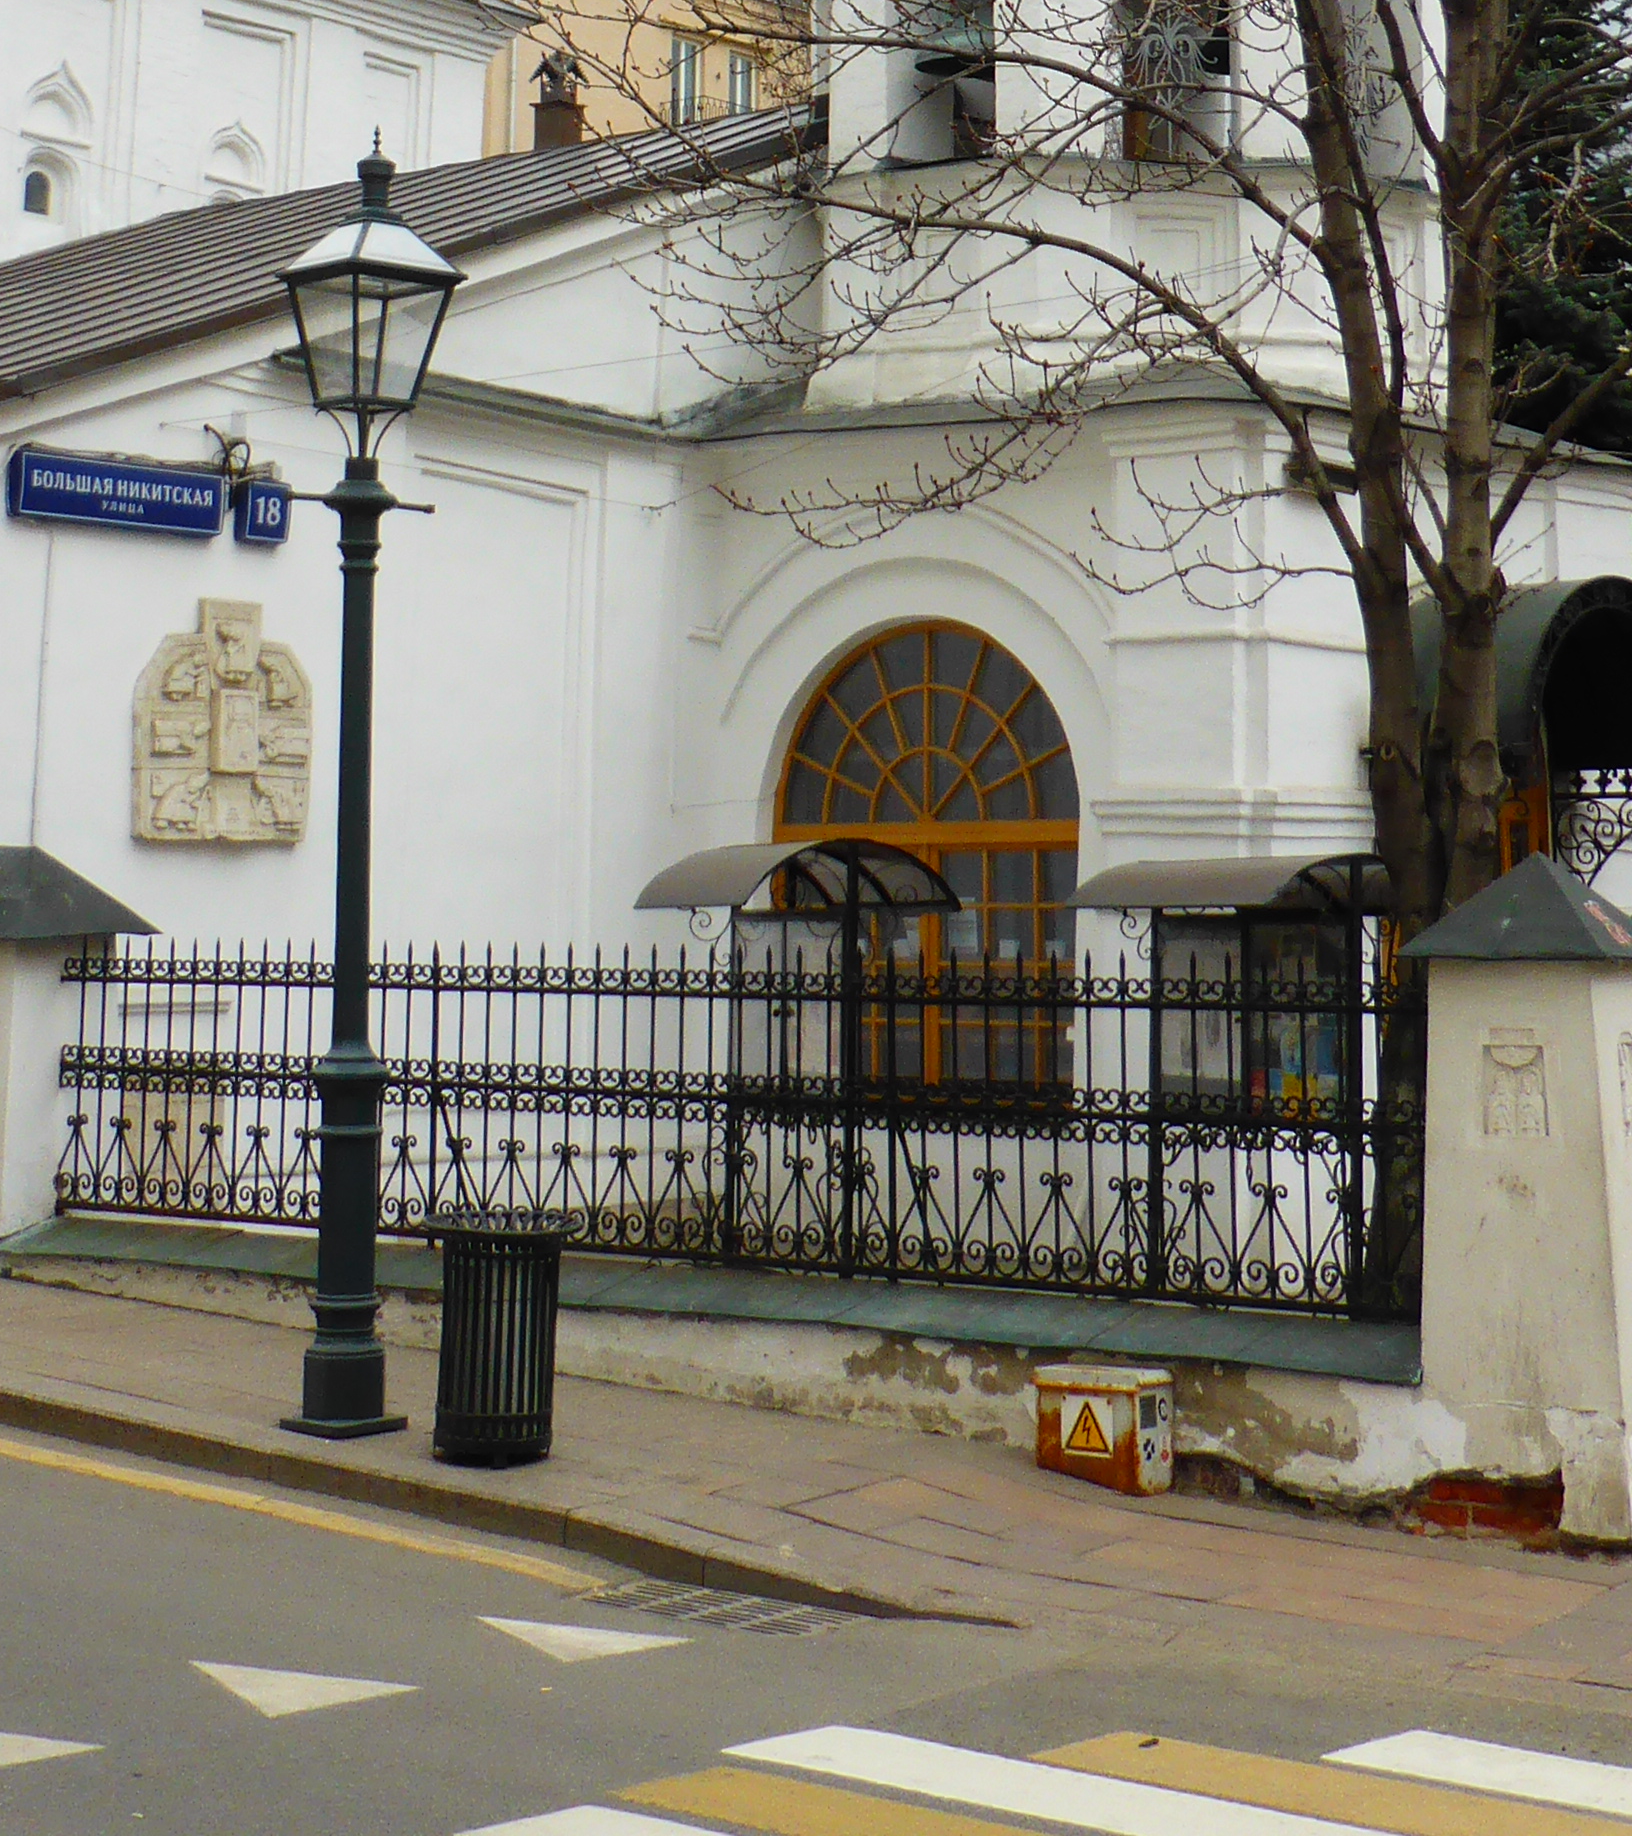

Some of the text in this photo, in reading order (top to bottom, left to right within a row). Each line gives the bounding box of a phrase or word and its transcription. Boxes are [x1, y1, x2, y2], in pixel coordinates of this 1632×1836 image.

[31, 469, 213, 507] БОЛЬШАЯ НИКИТСКАЯ
[102, 501, 144, 514] УЛИЦА
[256, 496, 281, 526] 18
